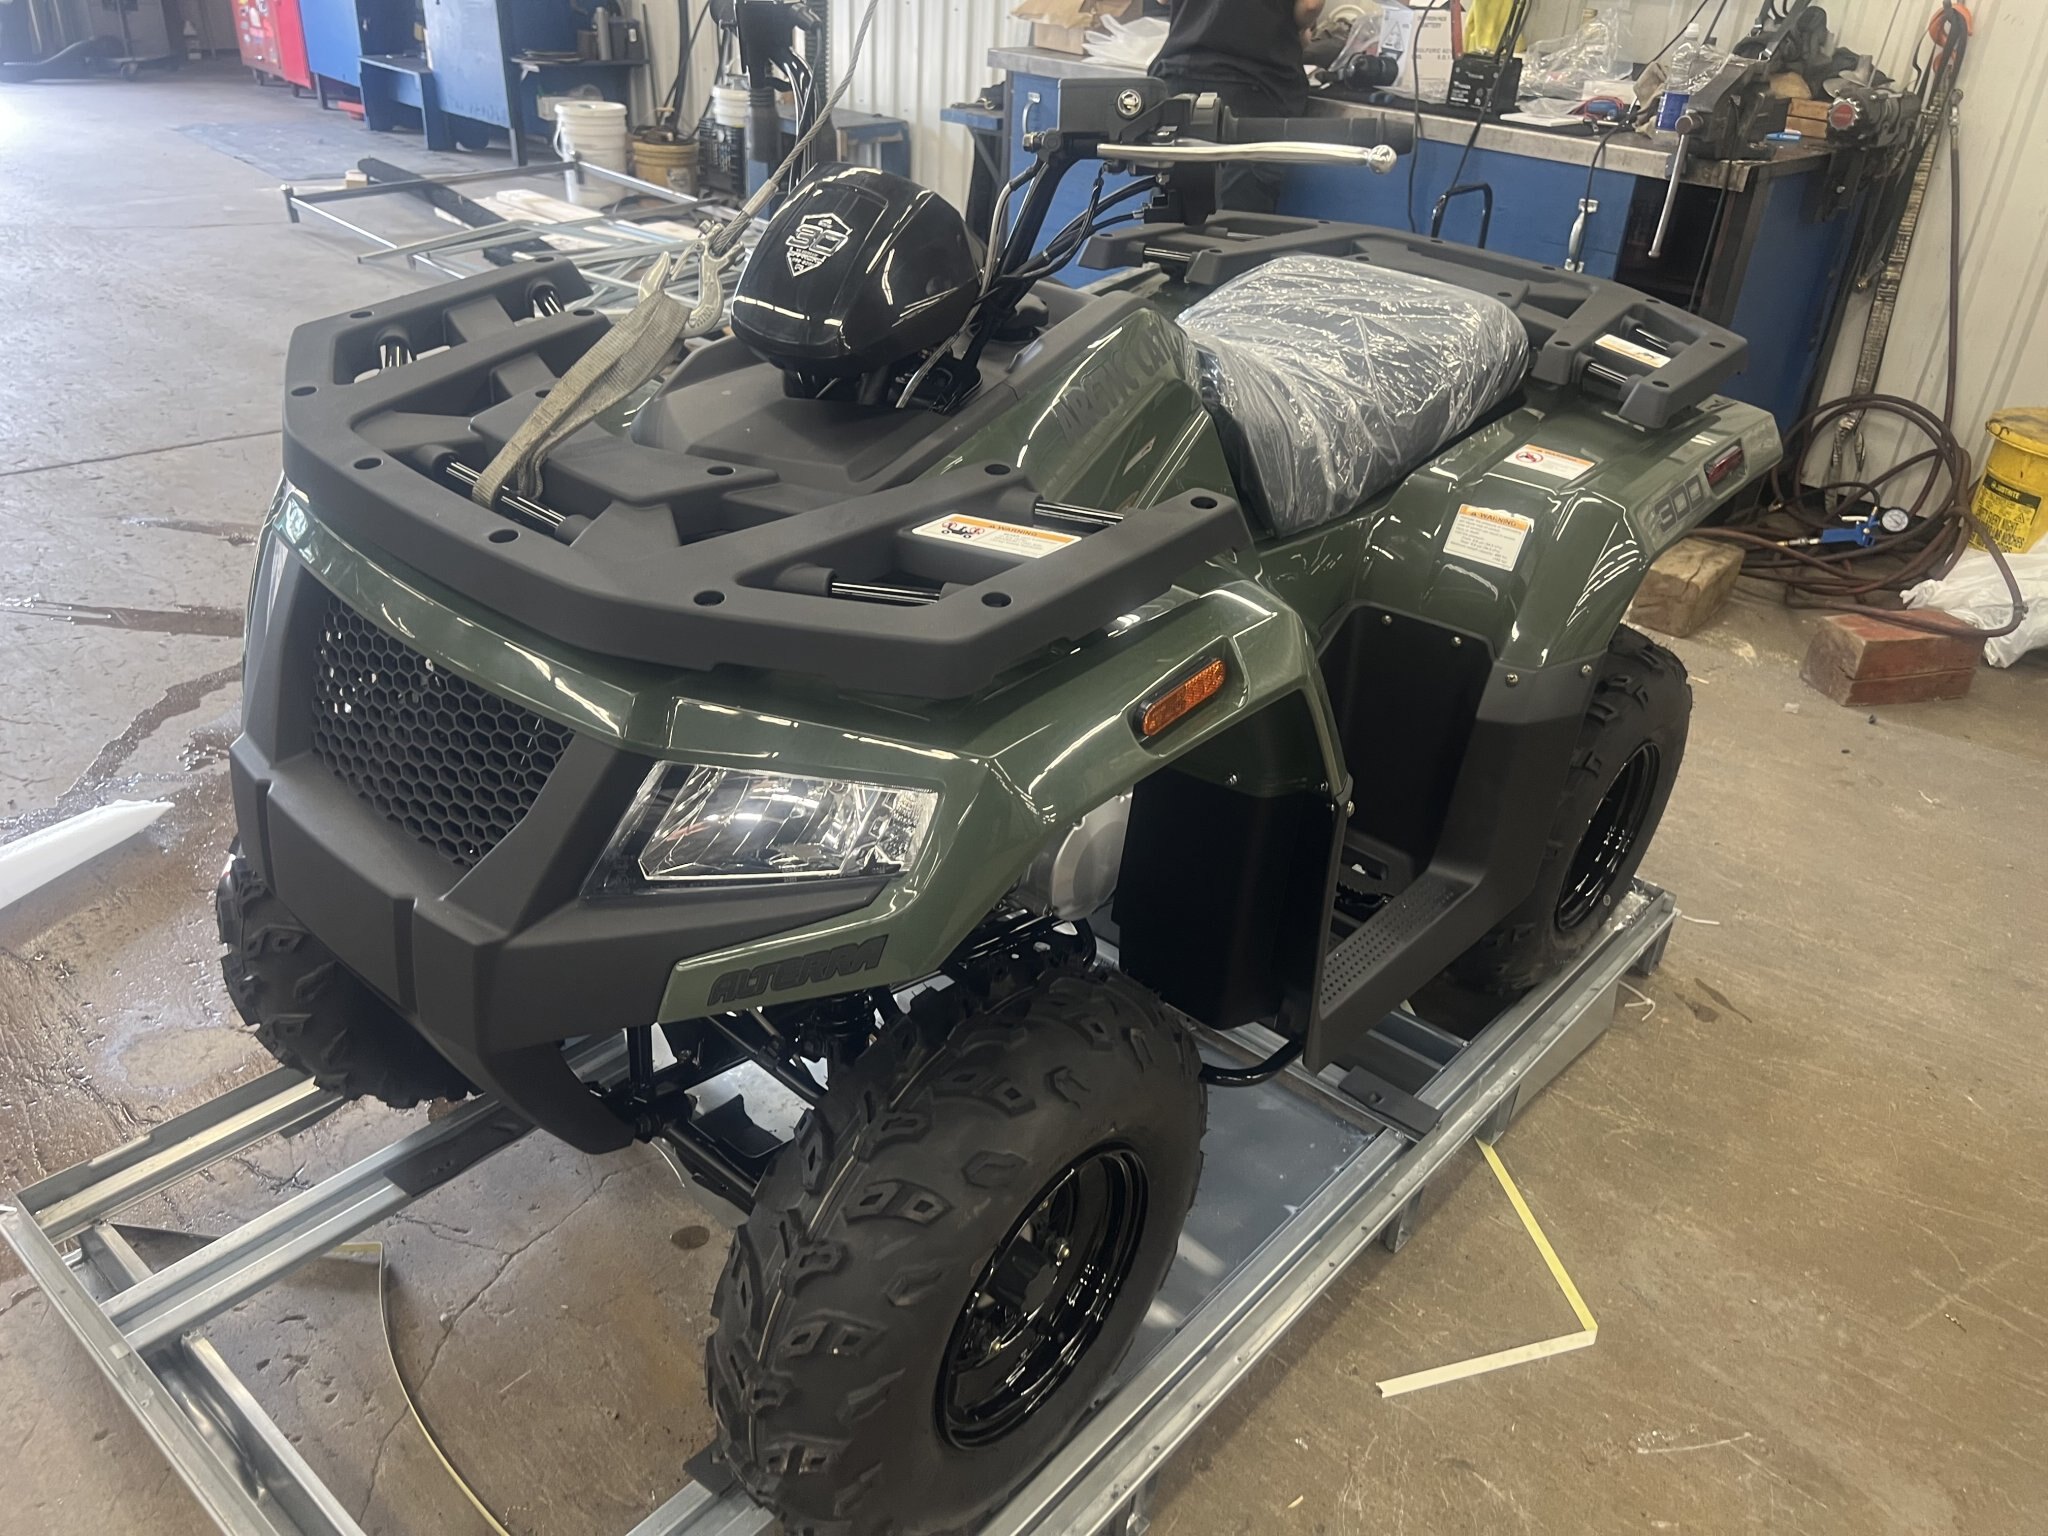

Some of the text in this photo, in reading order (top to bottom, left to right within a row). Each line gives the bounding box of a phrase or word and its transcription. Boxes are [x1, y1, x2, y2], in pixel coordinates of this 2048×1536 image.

[785, 223, 848, 257] 30
[1480, 512, 1517, 527] WARNING
[1654, 474, 1702, 533] 300
[998, 525, 1038, 537] WARNING
[707, 934, 889, 1006] ALTERRA
